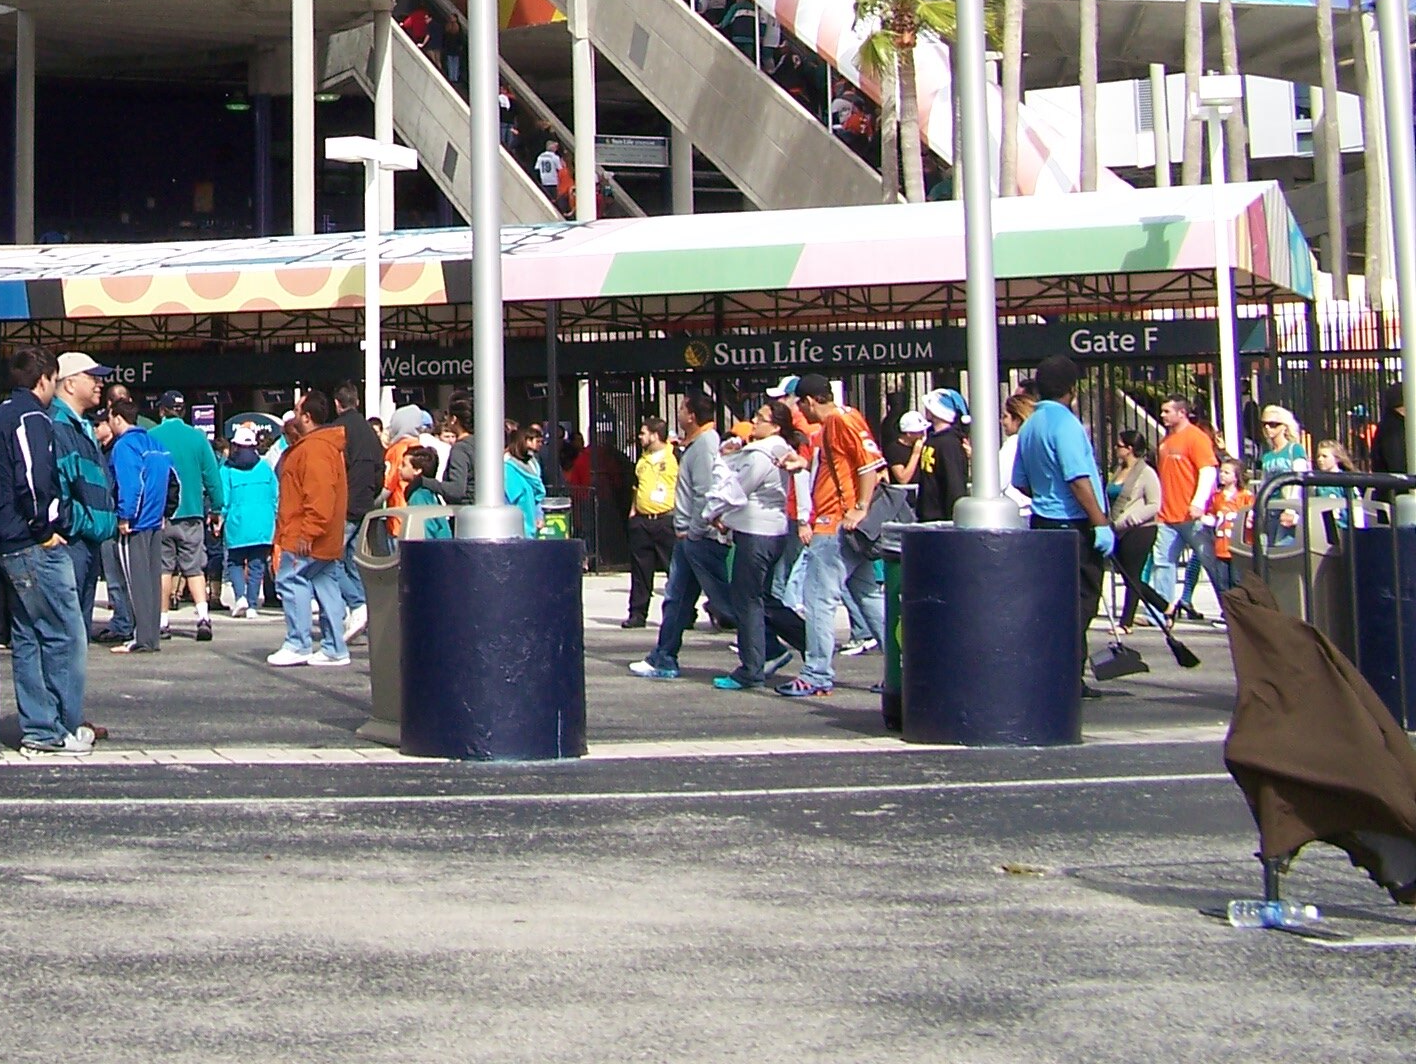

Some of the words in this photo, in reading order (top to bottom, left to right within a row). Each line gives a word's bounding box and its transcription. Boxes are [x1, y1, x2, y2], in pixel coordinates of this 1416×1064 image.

[714, 343, 766, 366] Sun
[772, 338, 824, 364] Life
[832, 342, 933, 362] STADIUM
[1070, 329, 1136, 353] Gate
[1144, 327, 1158, 351] F
[142, 362, 154, 382] F
[381, 354, 473, 377] Welcome
